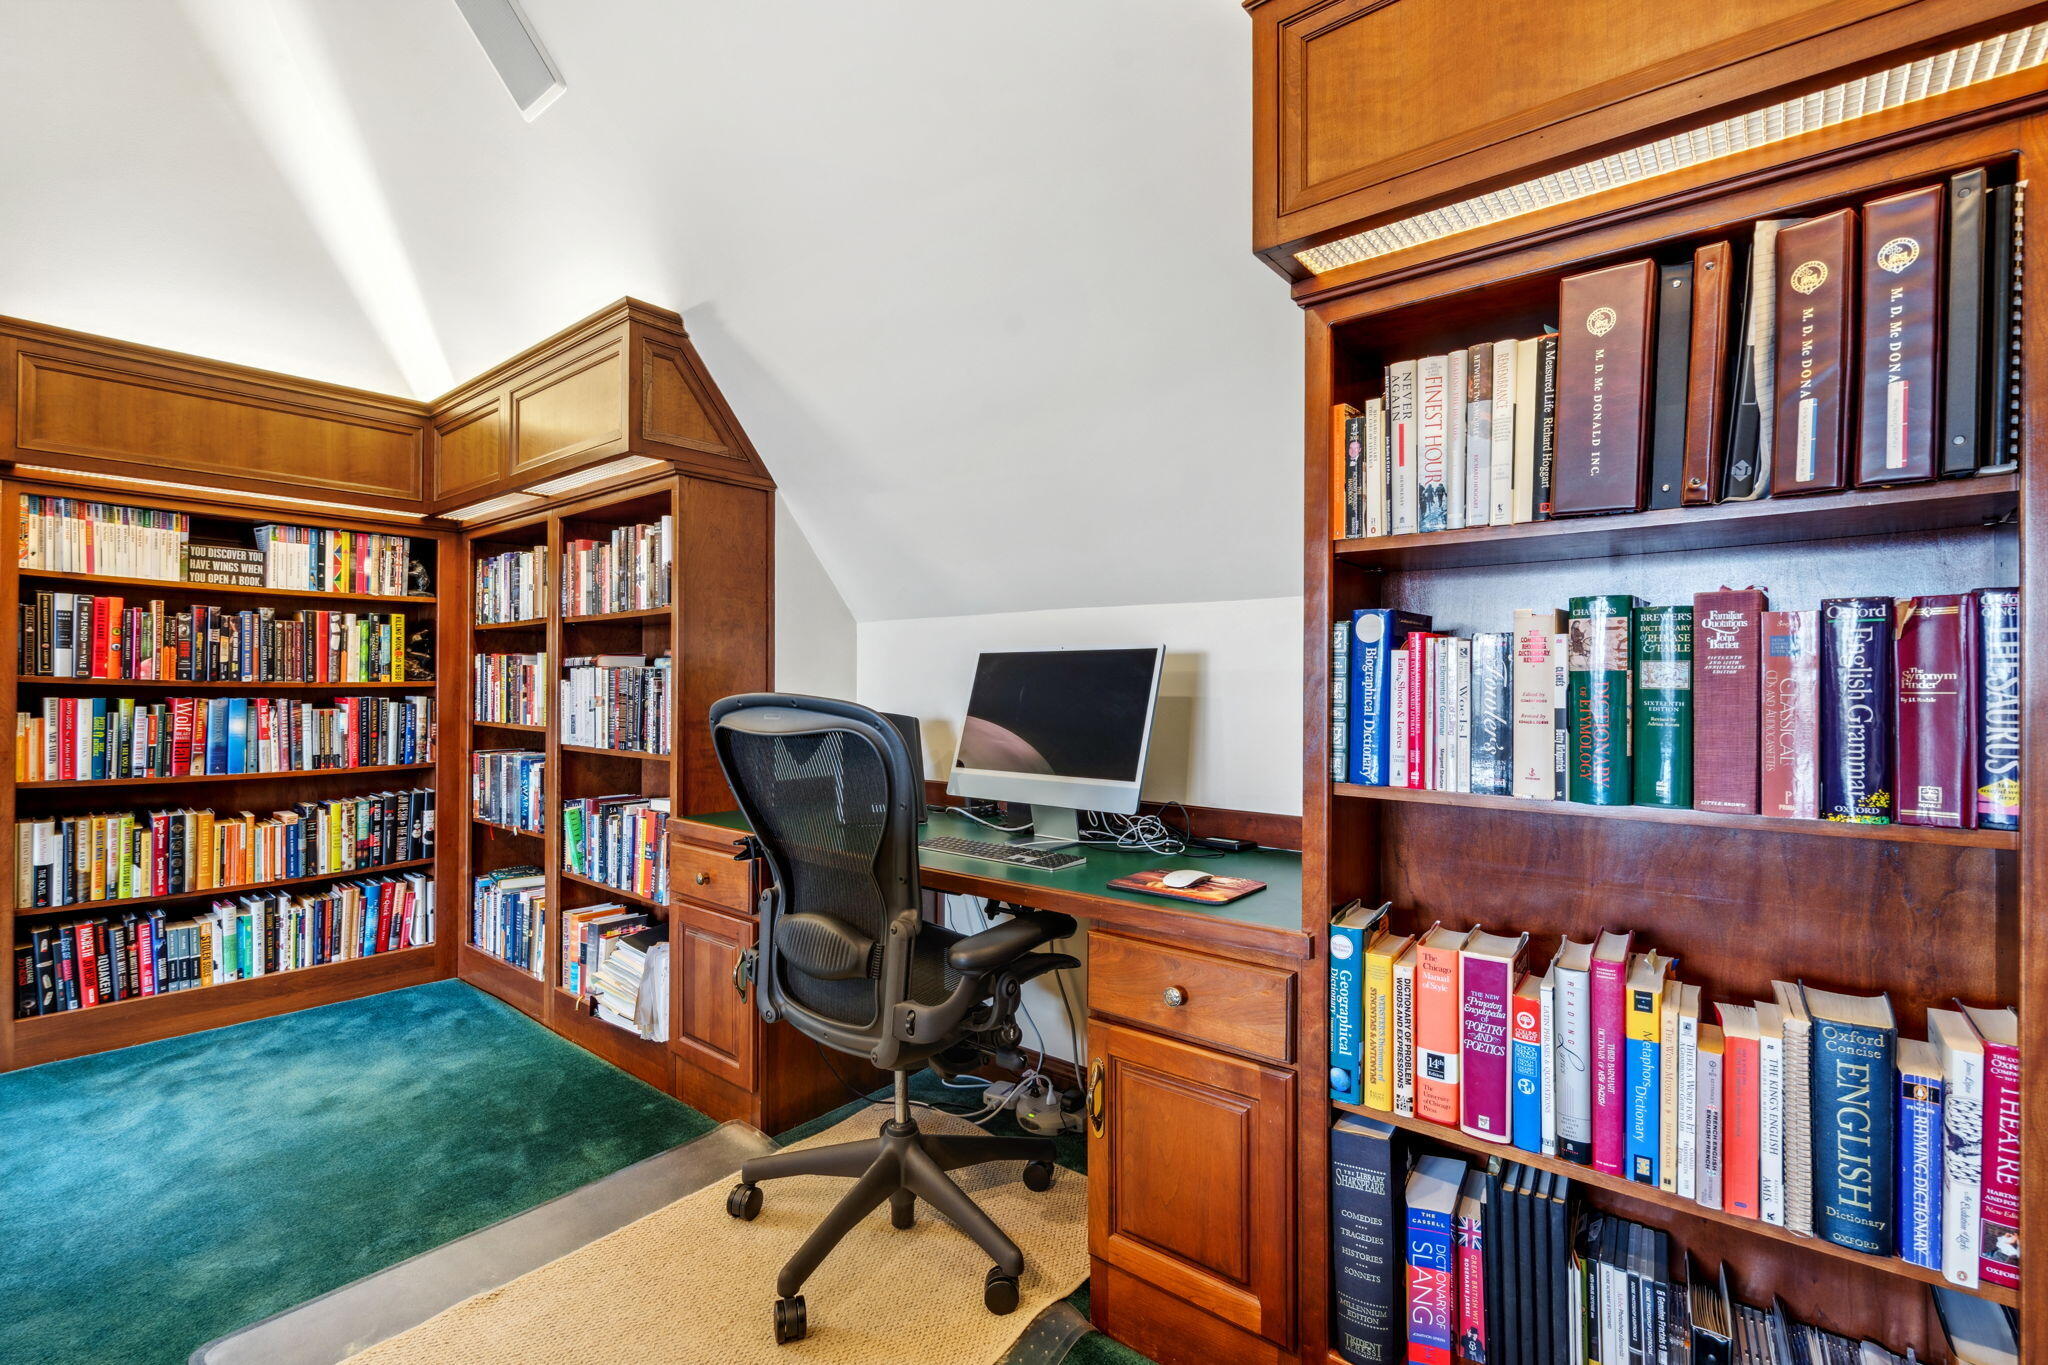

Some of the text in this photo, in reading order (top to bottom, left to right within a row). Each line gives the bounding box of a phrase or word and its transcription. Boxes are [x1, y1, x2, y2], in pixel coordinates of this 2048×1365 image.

[1392, 375, 1401, 422] AGAIN
[1402, 372, 1412, 420] NEVER
[1540, 340, 1555, 488] A Measured Life Richard Hoggart
[1591, 349, 1604, 476] M. D. Mc DONALD INC.
[1424, 376, 1442, 486] FINEST HOUR
[190, 546, 264, 562] YOU DISCOVER YOU
[190, 558, 264, 574] HAVE WINGS WHEN
[190, 572, 263, 587] YOU OPEN A BOOK.
[1640, 613, 1692, 622] BREWER'S
[1709, 610, 1744, 620] Familiar
[1826, 604, 1886, 618] Oxford
[80, 612, 88, 642] SPLENDID
[1702, 618, 1748, 630] Quotations
[1709, 640, 1740, 650] Bartlett
[1714, 632, 1736, 642] John
[1902, 670, 1957, 684] Synonym
[1902, 680, 1938, 690] Finder
[1396, 681, 1406, 708] Shoots
[1481, 654, 1508, 754] Fowler's
[1984, 628, 2020, 774] THESAURUS
[1360, 648, 1377, 778] Biographical Dictionary
[1397, 710, 1405, 718] &
[1780, 677, 1798, 764] CLASSICAL
[1840, 626, 1874, 800] English Grammar
[174, 701, 194, 764] Wolf Hall
[1396, 720, 1405, 750] Leaves
[1580, 700, 1592, 780] ETYMOLOGY
[1594, 682, 1610, 788] DICTIONARY
[520, 780, 529, 816] SWARM
[38, 868, 46, 896] THE NOVEL
[382, 886, 392, 916] The Quick
[80, 926, 94, 958] MACBETH
[201, 936, 212, 978] STOLEN SOULS
[1422, 952, 1438, 962] The
[1422, 962, 1452, 974] Chicago
[97, 958, 112, 995] QUAKER
[1422, 972, 1450, 983] Manual
[1422, 982, 1448, 993] of Style
[1330, 967, 1339, 1016] Dictionary
[1471, 990, 1500, 1001] THE NEW
[1336, 970, 1353, 1056] Geographical
[1464, 1005, 1506, 1019] Encyclopedia
[1467, 996, 1503, 1012] Princeton
[1567, 980, 1575, 1045] READING
[1396, 976, 1404, 1089] WORDS AND EXPRESSIONS
[1404, 978, 1412, 1086] DICTIONARY OF PROBLEM
[1465, 1020, 1506, 1036] POETRY
[1474, 1032, 1494, 1043] AND
[1822, 1026, 1886, 1048] Oxford
[1464, 1038, 1506, 1057] POETICS
[1825, 1040, 1882, 1060] Concise
[1428, 1056, 1444, 1070] 14th
[1428, 1070, 1444, 1079] Edition
[1607, 1044, 1616, 1095] THIRD BARNHART
[1664, 1028, 1674, 1105] THE WORD MUSEUM
[1633, 1030, 1655, 1142] Metaphors Dictionary
[1769, 1059, 1778, 1156] THE KING'S ENGLISH
[1835, 1058, 1872, 1212] ENGLISH
[1335, 1168, 1386, 1196] SHAKSPEARE
[1356, 1172, 1386, 1182] LIBRARY
[1762, 1176, 1772, 1202] AMIS
[1913, 1116, 1929, 1256] RHYMING DICTIONARY
[1984, 1194, 2002, 1204] AND
[1985, 1206, 2003, 1216] New
[1341, 1210, 1383, 1226] COMEDIES
[1412, 1218, 1446, 1228] CASSELL
[1826, 1205, 1886, 1230] Dictionary
[1340, 1227, 1384, 1244] TRAGEDIES
[1832, 1232, 1880, 1250] OXFORD
[1341, 1246, 1384, 1264] HISTORIES
[1344, 1266, 1381, 1284] SONNETS
[1412, 1240, 1434, 1326] SLANG
[1436, 1244, 1447, 1330] DICTIONARY OF
[1339, 1298, 1388, 1318] MILLENNIUM
[1346, 1310, 1380, 1326] EDITION
[1656, 1296, 1666, 1320] Genuine
[1658, 1320, 1667, 1344] Fractals
[1344, 1332, 1382, 1357] TRIDENT
